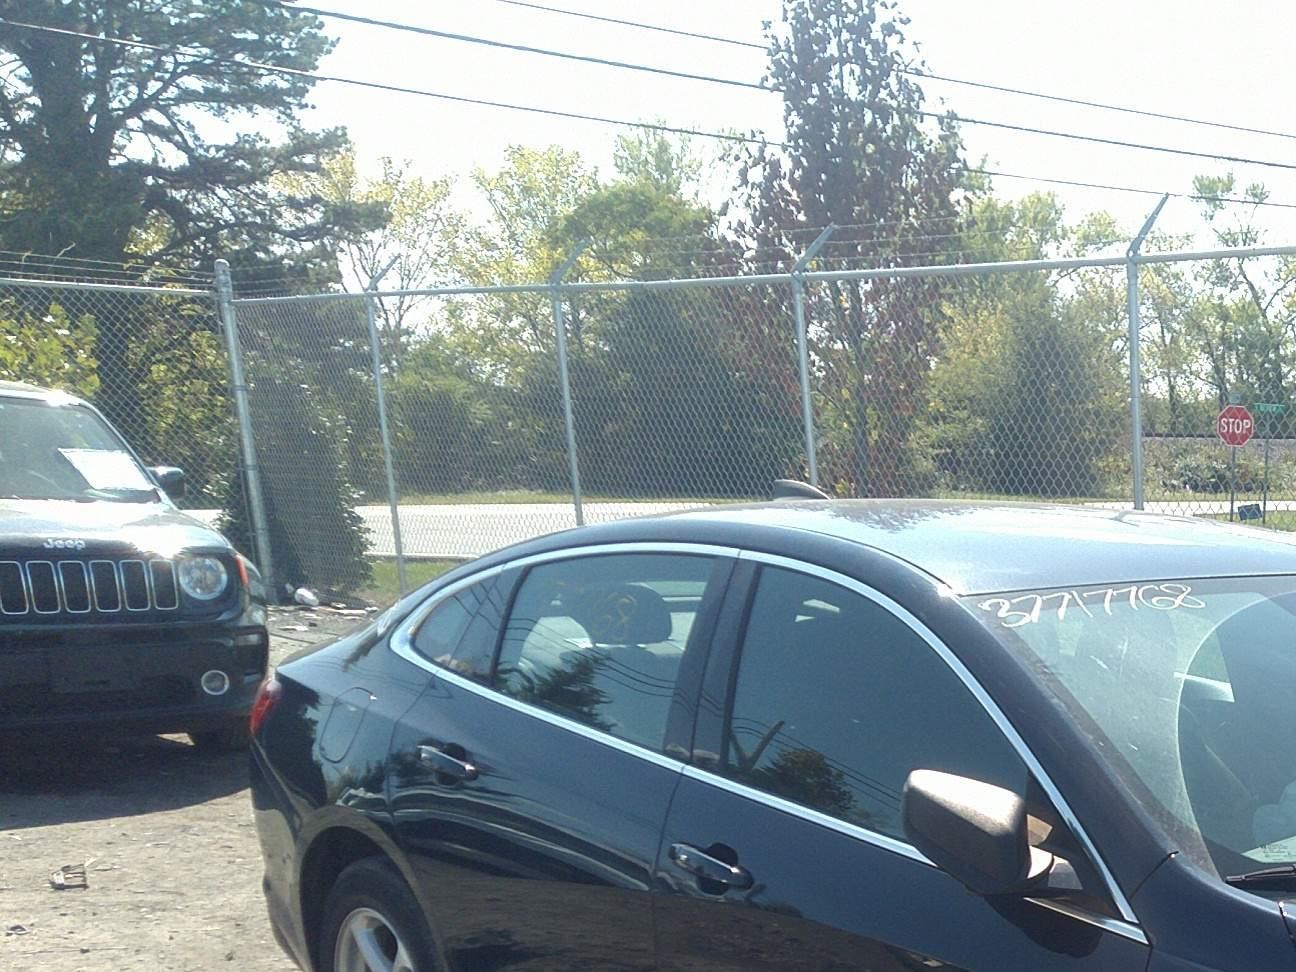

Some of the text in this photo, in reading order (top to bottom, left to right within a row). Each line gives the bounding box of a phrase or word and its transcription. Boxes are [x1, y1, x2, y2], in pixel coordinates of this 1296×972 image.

[1220, 418, 1252, 434] STOP
[42, 538, 86, 551] Jeep
[976, 583, 1206, 628] 37717768
